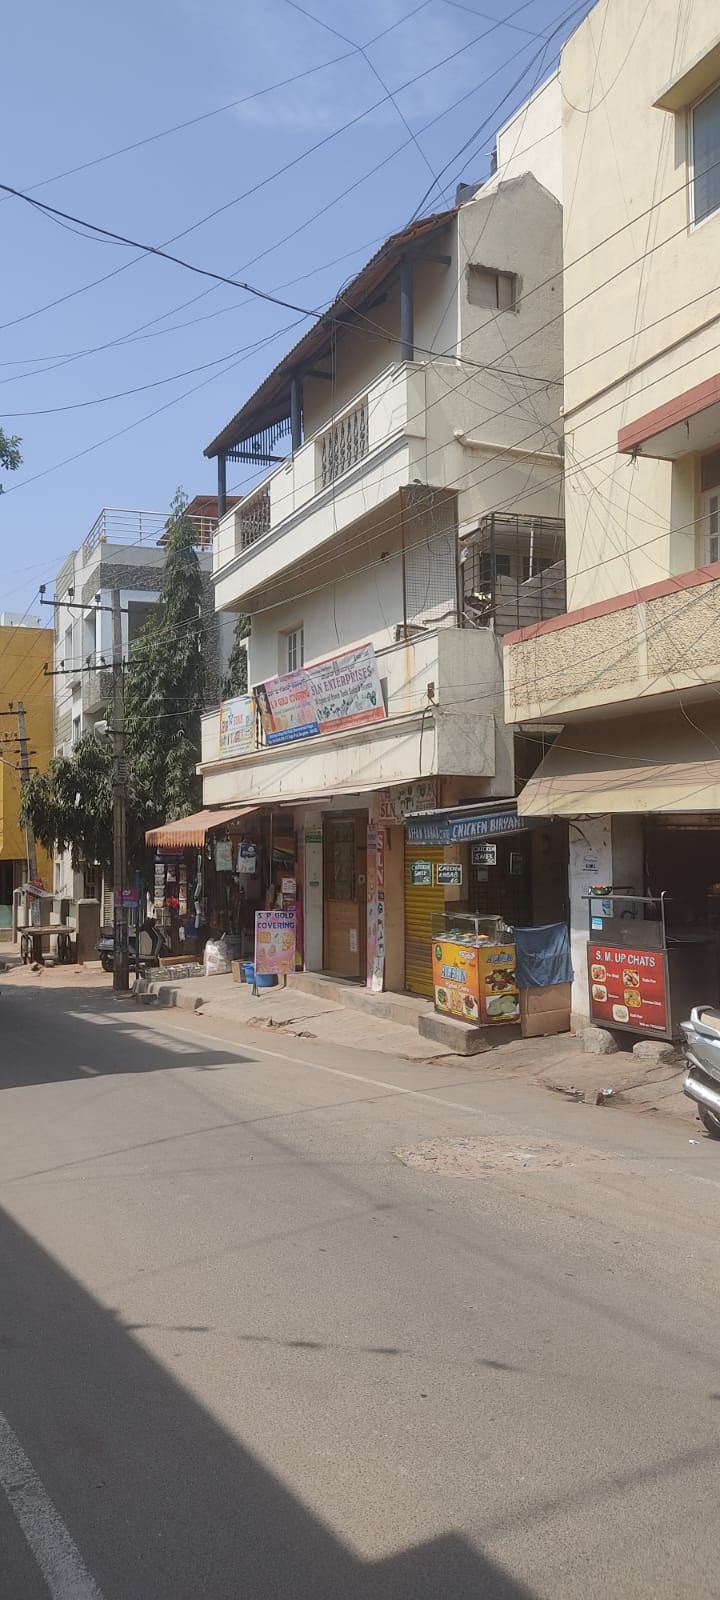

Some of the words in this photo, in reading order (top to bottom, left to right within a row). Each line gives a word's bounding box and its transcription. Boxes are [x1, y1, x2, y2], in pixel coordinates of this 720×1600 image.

[323, 665, 374, 692] ENTERPRISES
[452, 820, 488, 839] CHICKEN
[490, 815, 525, 832] BIRYANI
[595, 950, 603, 961] S.
[604, 951, 614, 962] M.
[615, 952, 627, 964] UP
[627, 954, 656, 968] CHATS
